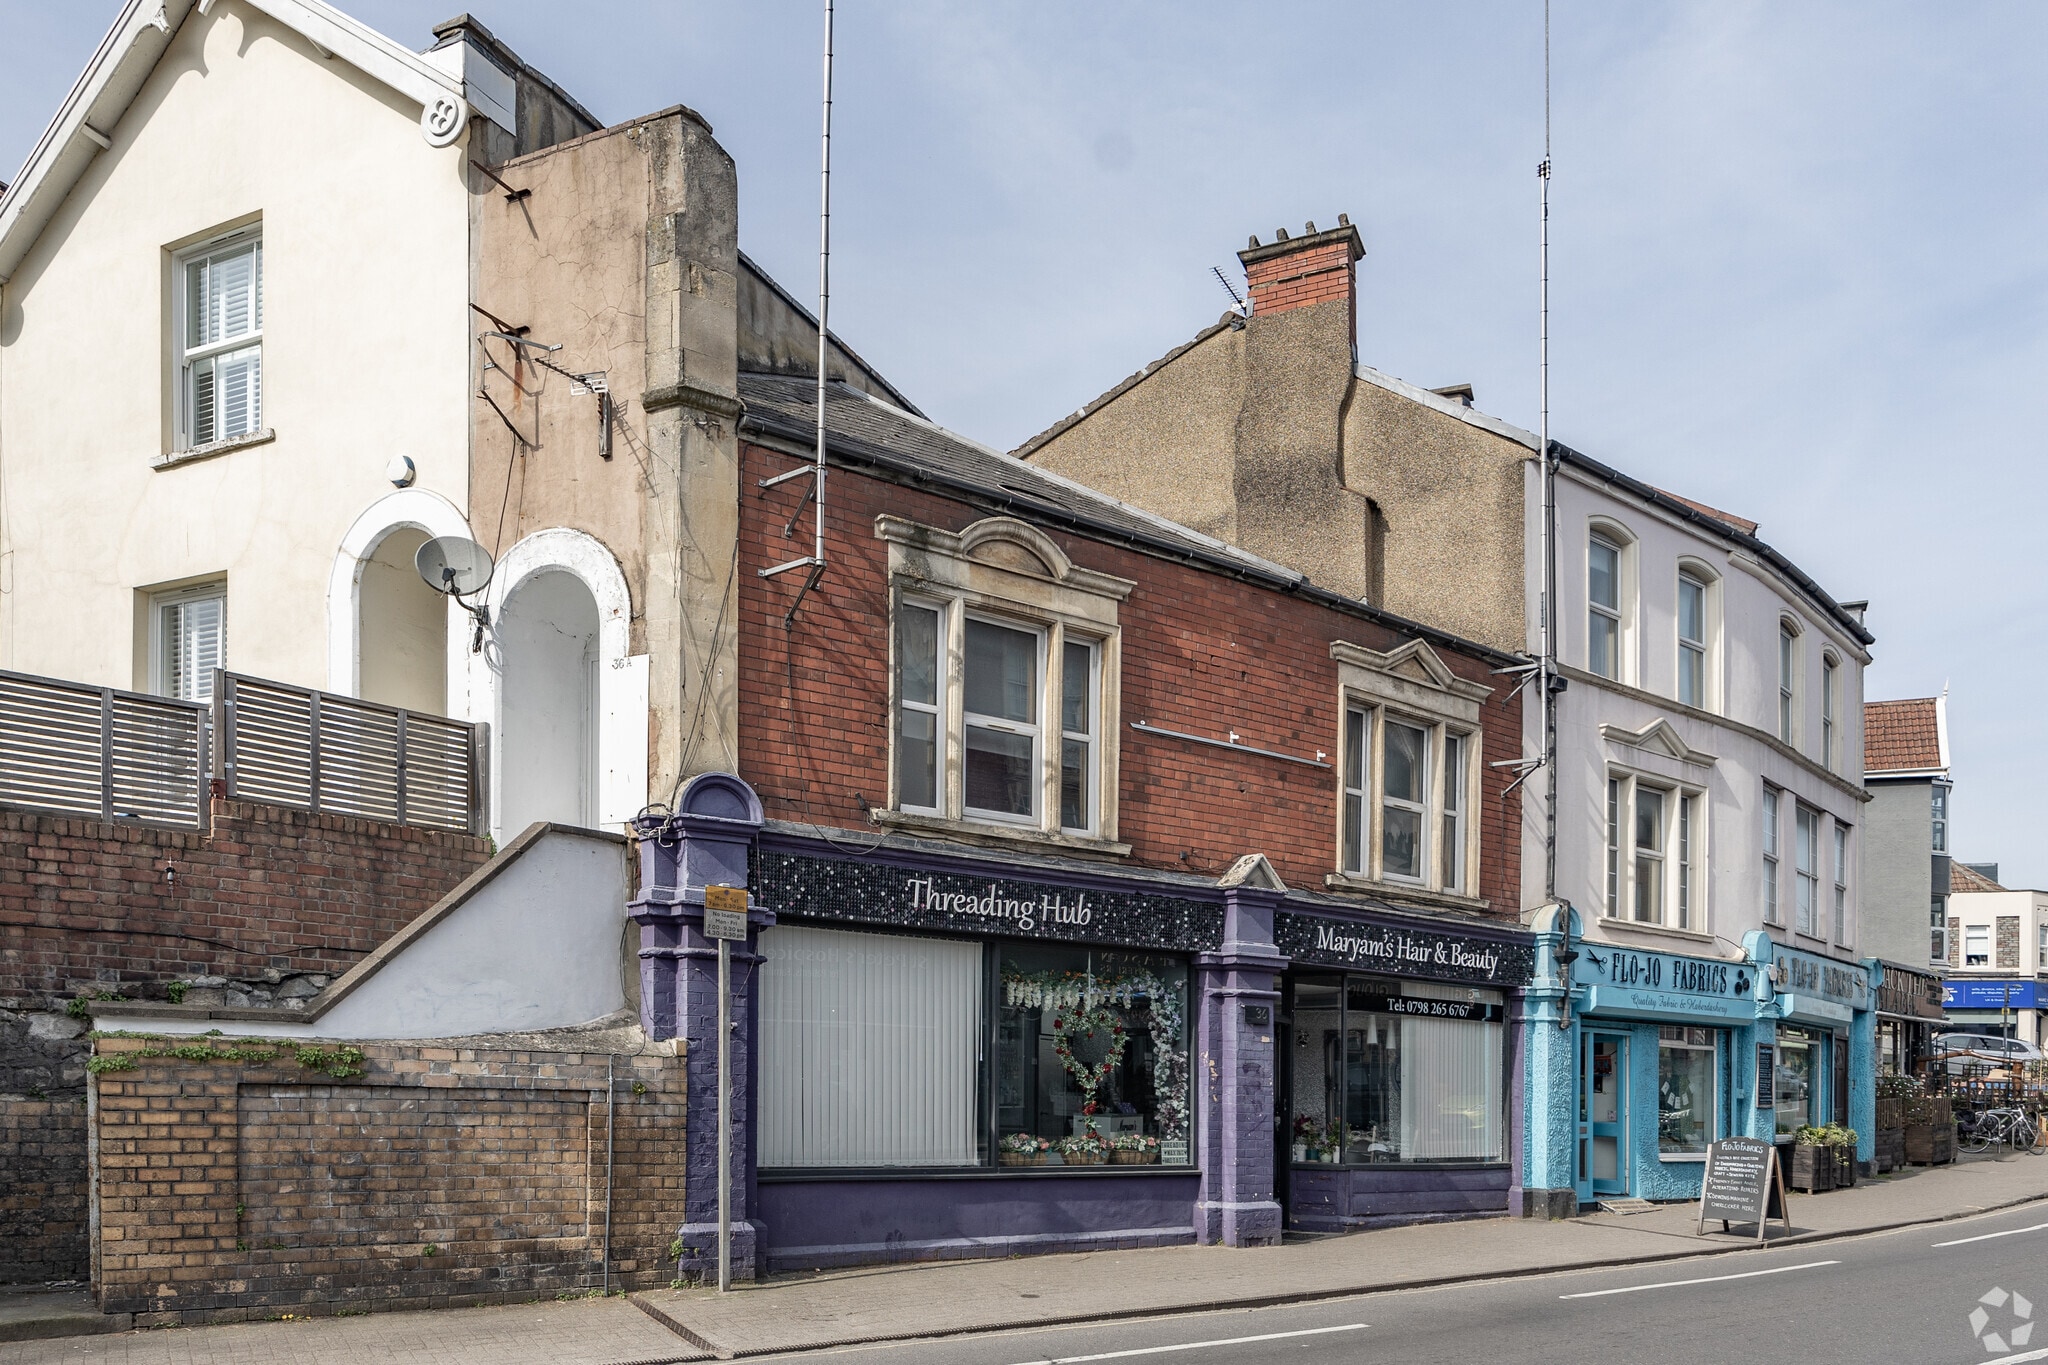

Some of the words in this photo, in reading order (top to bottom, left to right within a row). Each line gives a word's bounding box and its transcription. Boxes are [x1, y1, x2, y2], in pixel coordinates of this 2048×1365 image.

[721, 912, 741, 920] loading
[906, 878, 1035, 930] Threading
[1041, 894, 1092, 926] Hub
[1316, 925, 1394, 962] Maryam's
[1397, 937, 1432, 962] Hair
[1434, 942, 1448, 965] &
[1451, 943, 1499, 979] Beauty
[1612, 952, 1662, 986] FLO-JO
[1673, 960, 1727, 993] FABRICS
[1882, 967, 1904, 992] JACK
[1907, 973, 1928, 997] THE
[1255, 1007, 1268, 1020] 36
[1387, 997, 1405, 1012] Tel:
[1406, 1000, 1429, 1014] 0798
[1430, 1002, 1447, 1015] 265
[1448, 1003, 1470, 1017] 6767
[1630, 993, 1657, 1010] Quality
[1658, 994, 1679, 1008] Fabric
[1679, 998, 1687, 1008] &
